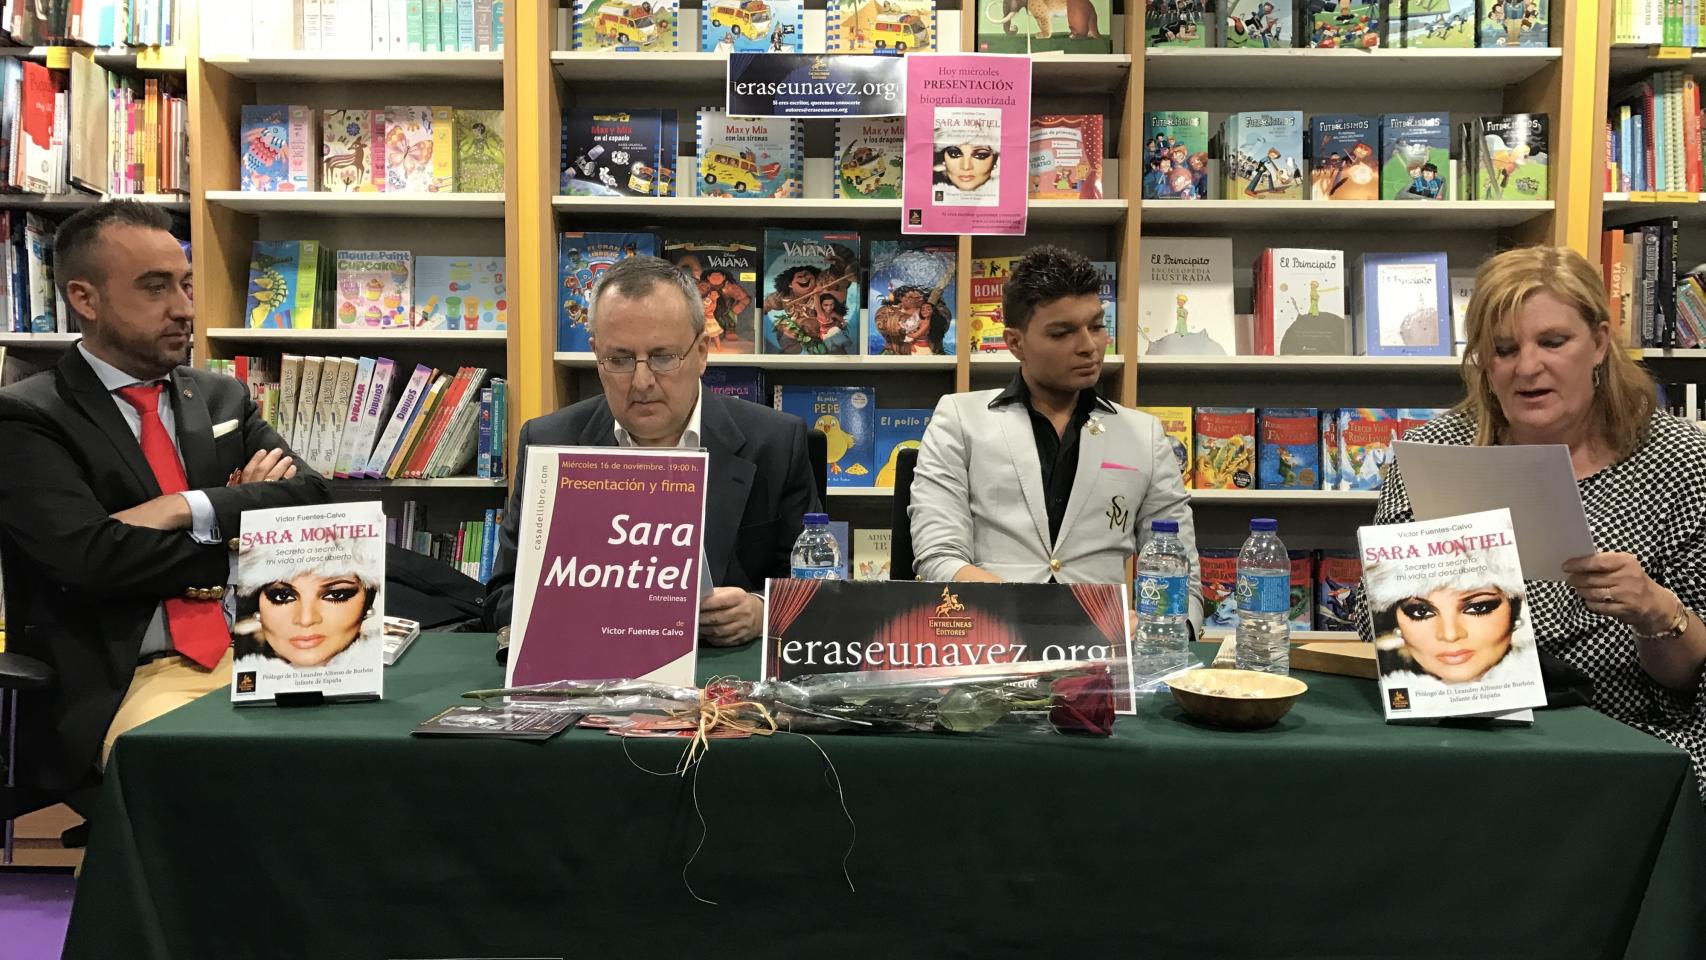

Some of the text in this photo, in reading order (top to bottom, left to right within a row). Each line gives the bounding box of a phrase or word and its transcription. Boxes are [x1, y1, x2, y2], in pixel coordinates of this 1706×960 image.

[939, 66, 1000, 78] Hoy miércoles
[736, 80, 896, 100] eraseunavez.org
[924, 79, 1014, 90] PRESENTACIÓN
[920, 94, 1016, 107] biografía autorizada
[592, 126, 608, 134] Max
[936, 118, 1000, 130] SARA MONTIEL
[726, 126, 744, 134] Max
[746, 128, 750, 136] y
[862, 126, 882, 134] Max
[883, 128, 888, 137] y
[602, 134, 608, 142] el
[608, 134, 630, 142] espacio
[783, 242, 836, 256] VAIANA
[338, 252, 373, 260] Mould
[380, 252, 410, 261] Paint
[708, 255, 749, 268] VAIANA
[1151, 254, 1210, 266] El Principito
[1280, 257, 1336, 270] El Principito
[1151, 274, 1211, 282] ILUSTRADA
[1612, 262, 1622, 298] MAGIA
[351, 384, 366, 422] DIBUJAR
[368, 383, 384, 416] DIBUJOS
[396, 388, 417, 420] DIBUJOS
[814, 404, 840, 414] PEPE
[880, 416, 920, 427] El pollo
[562, 460, 598, 469] Miércoles
[611, 462, 621, 470] de
[623, 462, 666, 471] noviembre.
[669, 463, 690, 472] 19:00
[692, 464, 699, 472] h.
[560, 476, 696, 494] Presentación y firma
[534, 464, 548, 551] casadellibro.com
[297, 512, 346, 521] Fuentes-Calvo
[608, 514, 694, 547] Sara
[1420, 523, 1472, 536] Fuentes-Calvo
[242, 524, 378, 548] SARA MONTIEL
[276, 547, 305, 556] Secreto
[314, 545, 344, 553] secreto
[1366, 532, 1513, 564] SARA MONTIEL
[266, 558, 276, 566] mi
[277, 556, 294, 565] vida
[306, 552, 352, 563] descubierto
[1404, 562, 1436, 571] Secreto
[1446, 556, 1478, 566] secreto
[544, 556, 694, 590] Montiel
[1408, 571, 1427, 580] vida
[1429, 569, 1437, 578] al
[1438, 564, 1488, 576] descubierto
[929, 620, 972, 628] ENTRELÍNEAS
[628, 627, 660, 636] Fuentes
[662, 628, 684, 637] Calvo
[936, 628, 966, 636] EDITORES
[782, 638, 1111, 669] eraseunavez.org
[1480, 684, 1502, 692] Alfonso
[1512, 680, 1534, 688] Borbón
[1480, 692, 1500, 700] España
